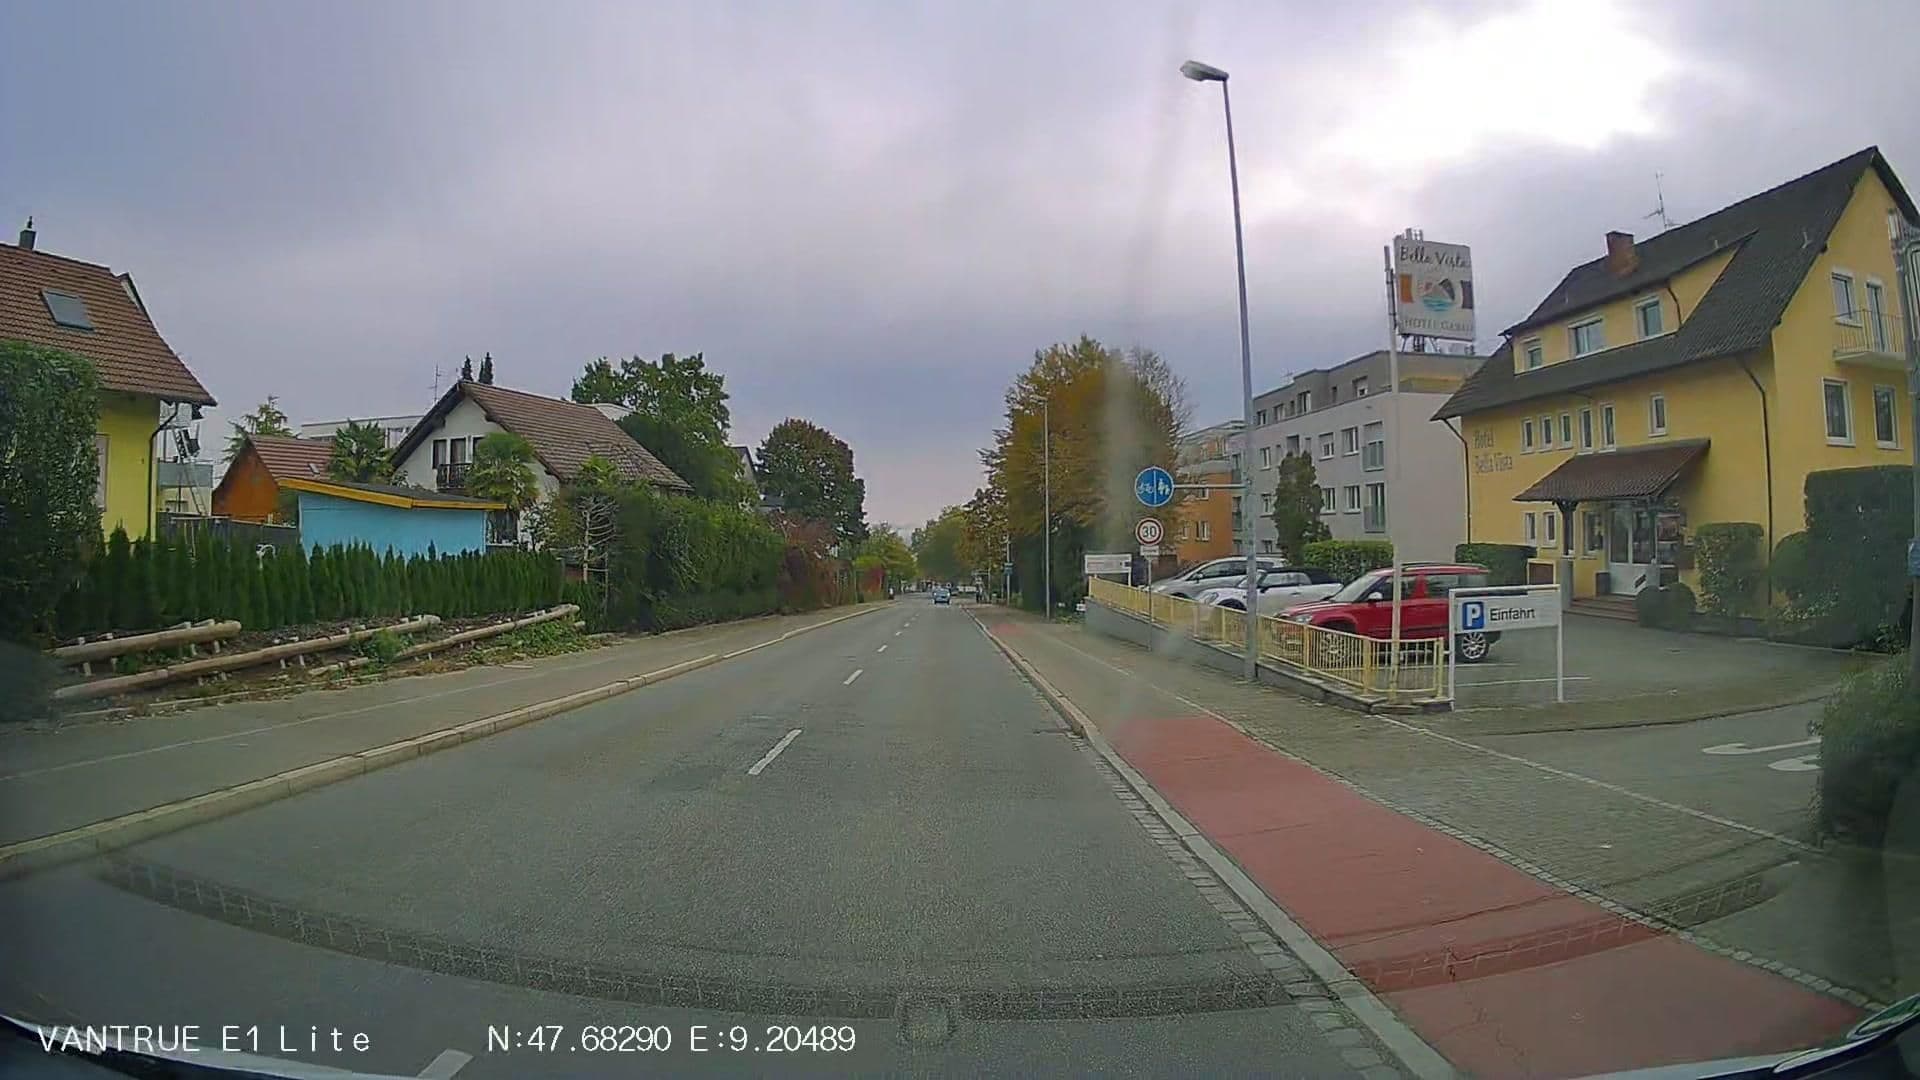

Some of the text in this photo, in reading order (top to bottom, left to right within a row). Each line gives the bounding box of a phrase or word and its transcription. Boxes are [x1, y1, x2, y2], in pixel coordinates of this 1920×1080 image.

[1404, 318, 1436, 329] HOTEL
[1142, 525, 1157, 538] 30
[1466, 603, 1536, 627] P Einfahrt
